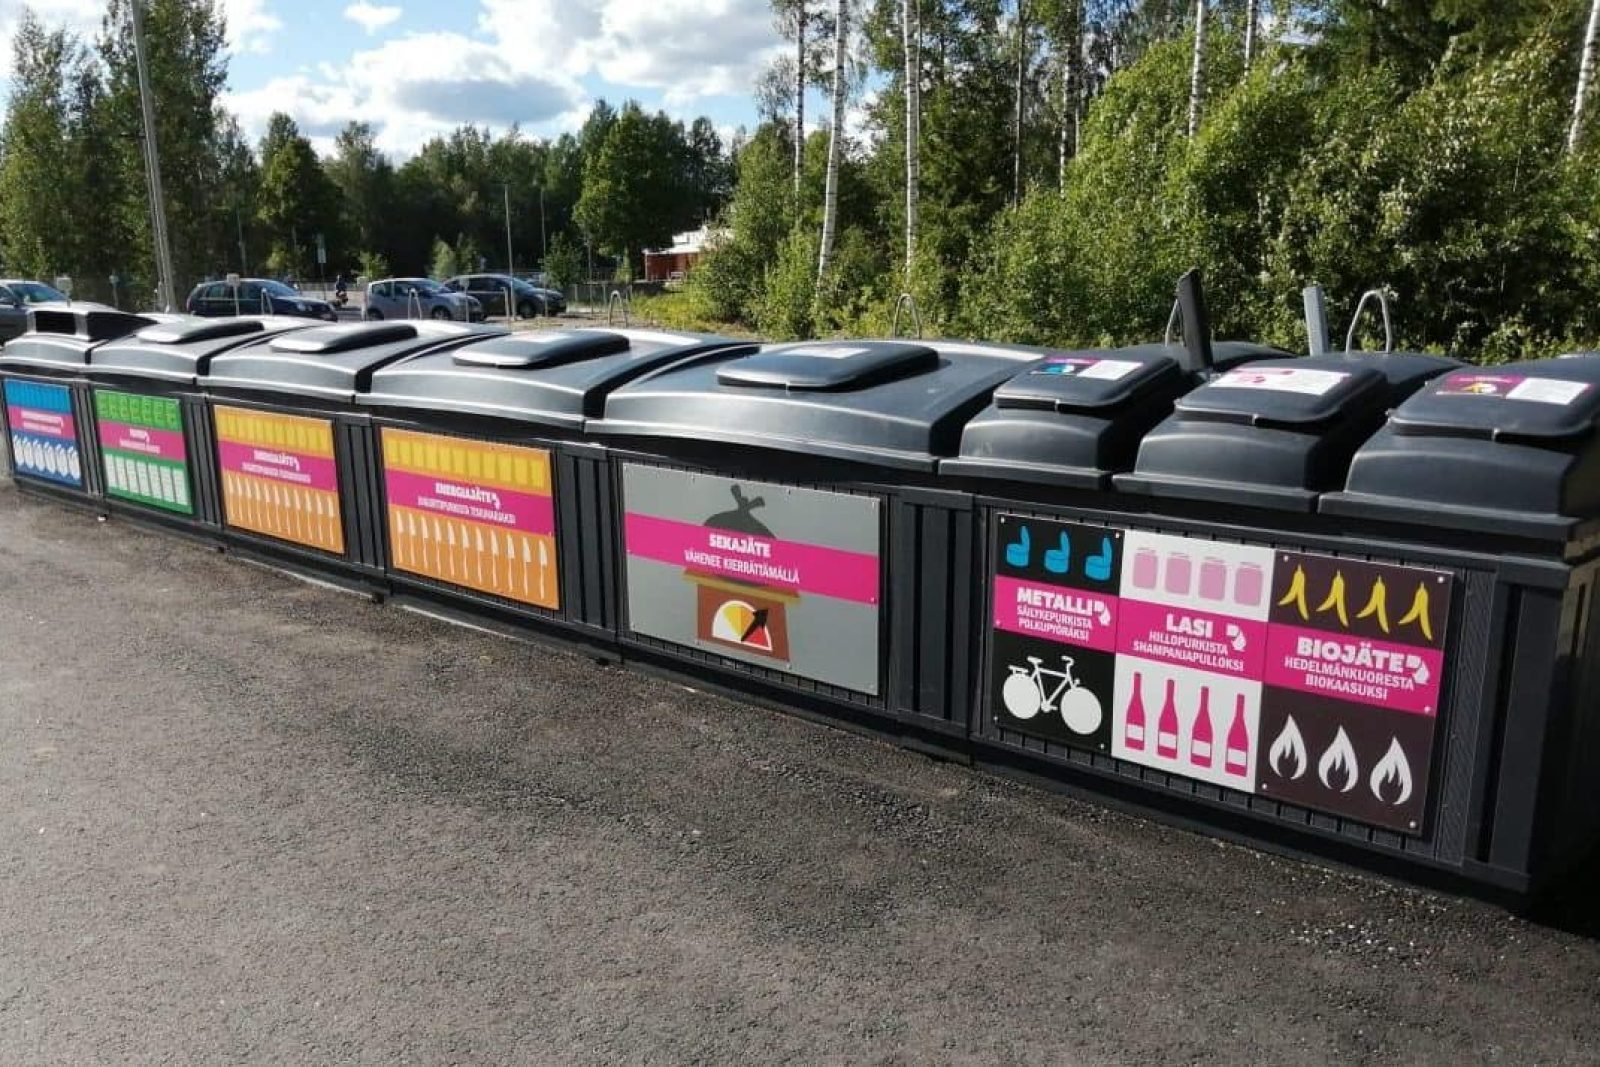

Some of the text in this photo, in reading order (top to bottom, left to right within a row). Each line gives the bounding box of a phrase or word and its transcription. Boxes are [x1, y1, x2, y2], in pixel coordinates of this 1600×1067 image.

[709, 533, 771, 557] SEKAJÄTE
[684, 549, 721, 568] VÄHENEE
[1017, 587, 1093, 616] METALLI
[1018, 618, 1090, 642] POLKUPYÖRÄKSI
[1166, 613, 1214, 638] LASI
[1133, 640, 1244, 671] SHAMPANJAPULLOKSI
[1149, 631, 1228, 655] HILLOPURKISTA
[1297, 636, 1405, 673] BIOJÄTE
[1284, 656, 1415, 690] HEDELMÄNKUORESTA
[1305, 673, 1389, 700] BIOKAASUKSI
